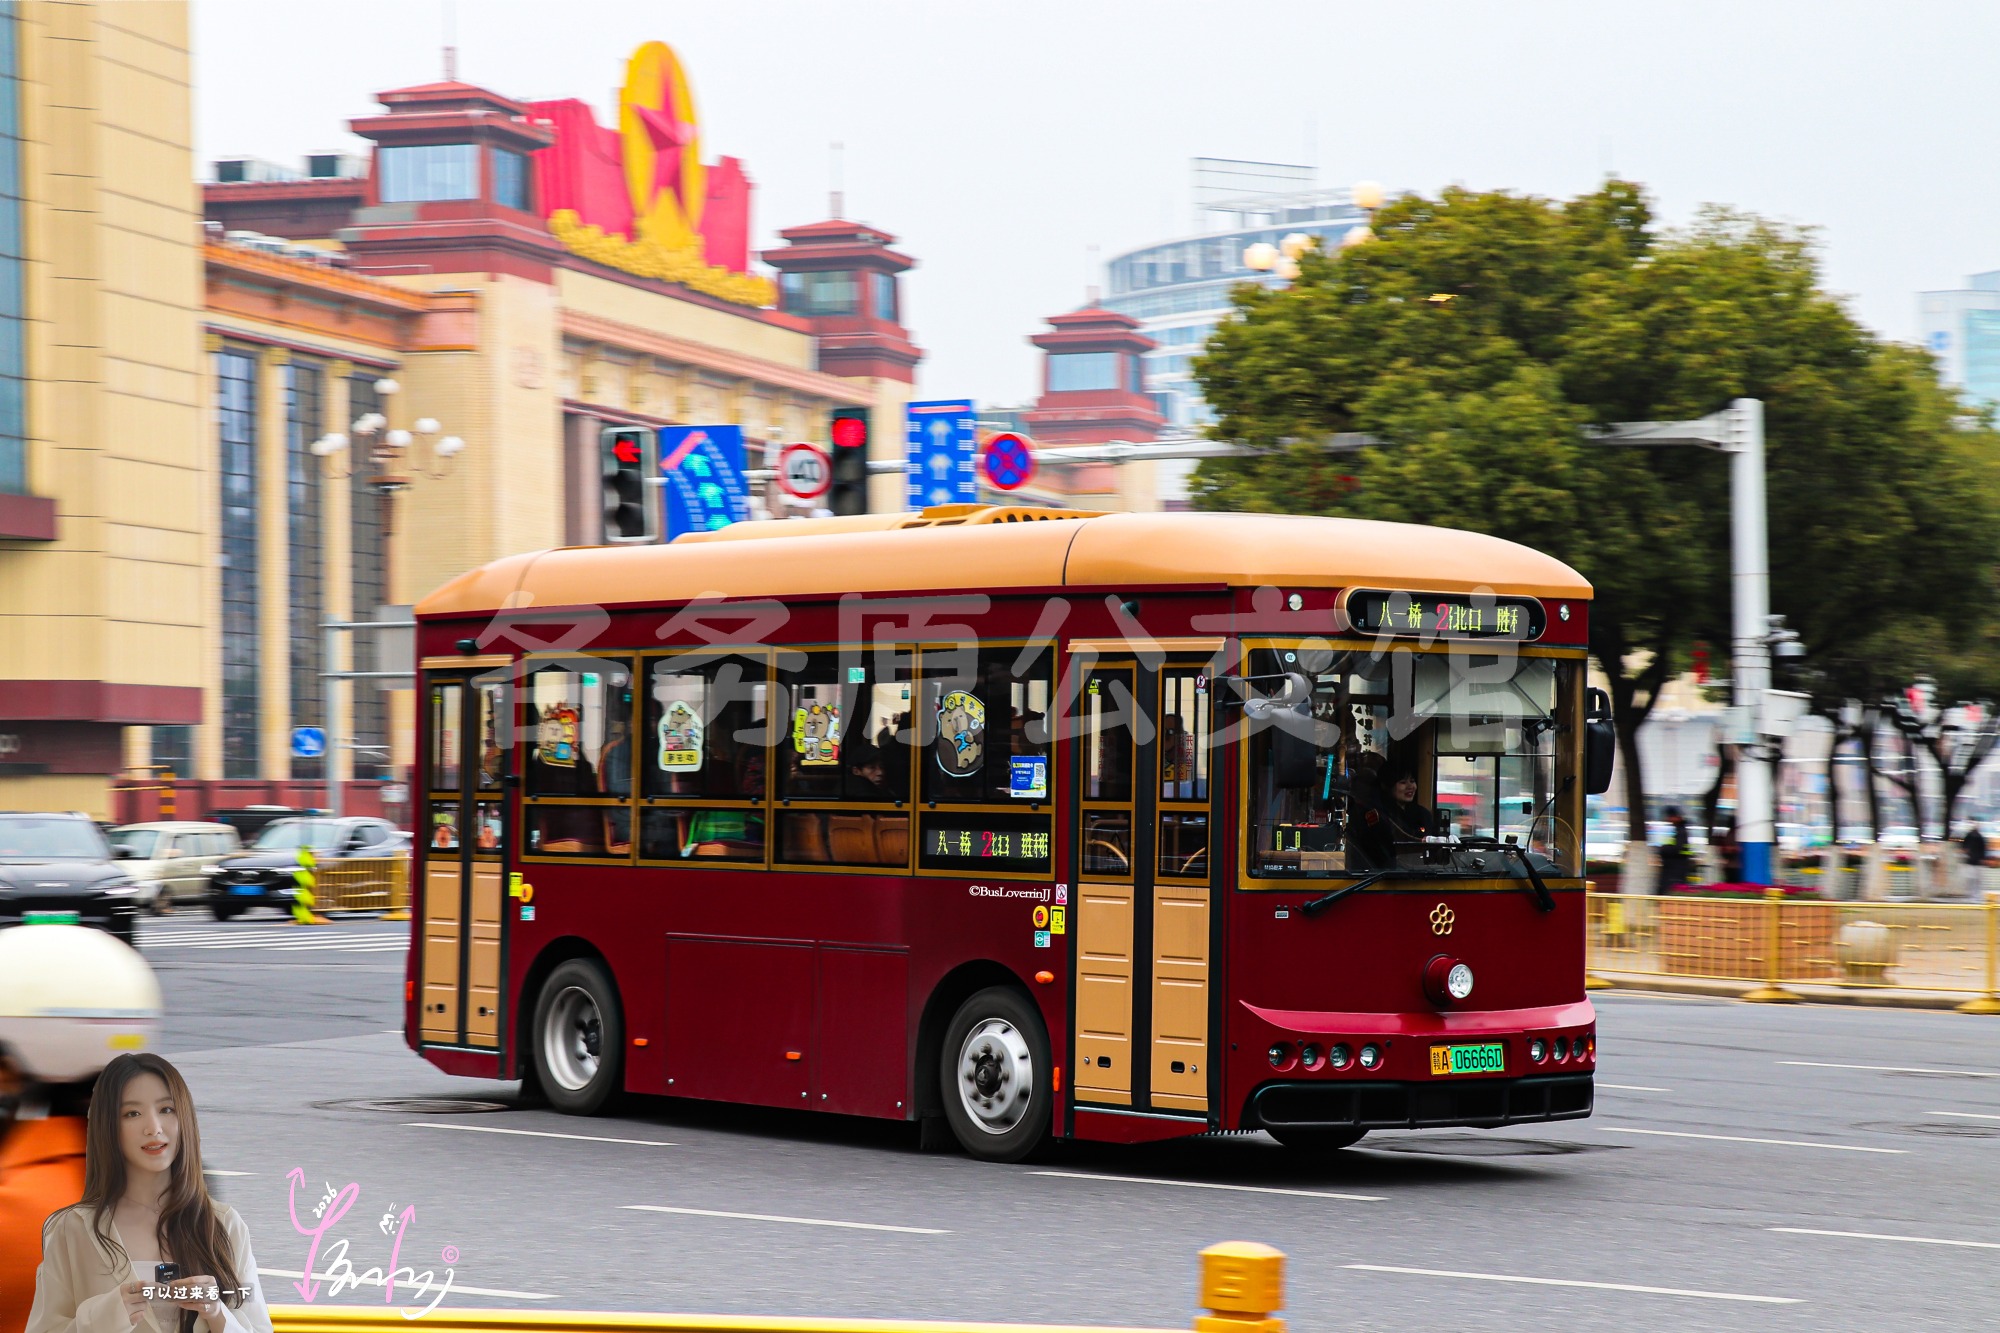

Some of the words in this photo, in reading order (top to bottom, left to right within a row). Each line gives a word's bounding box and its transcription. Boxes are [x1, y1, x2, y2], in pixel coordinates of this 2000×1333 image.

[1378, 601, 1422, 629] 八一桥
[1435, 602, 1449, 630] 2
[981, 831, 993, 857] 2
